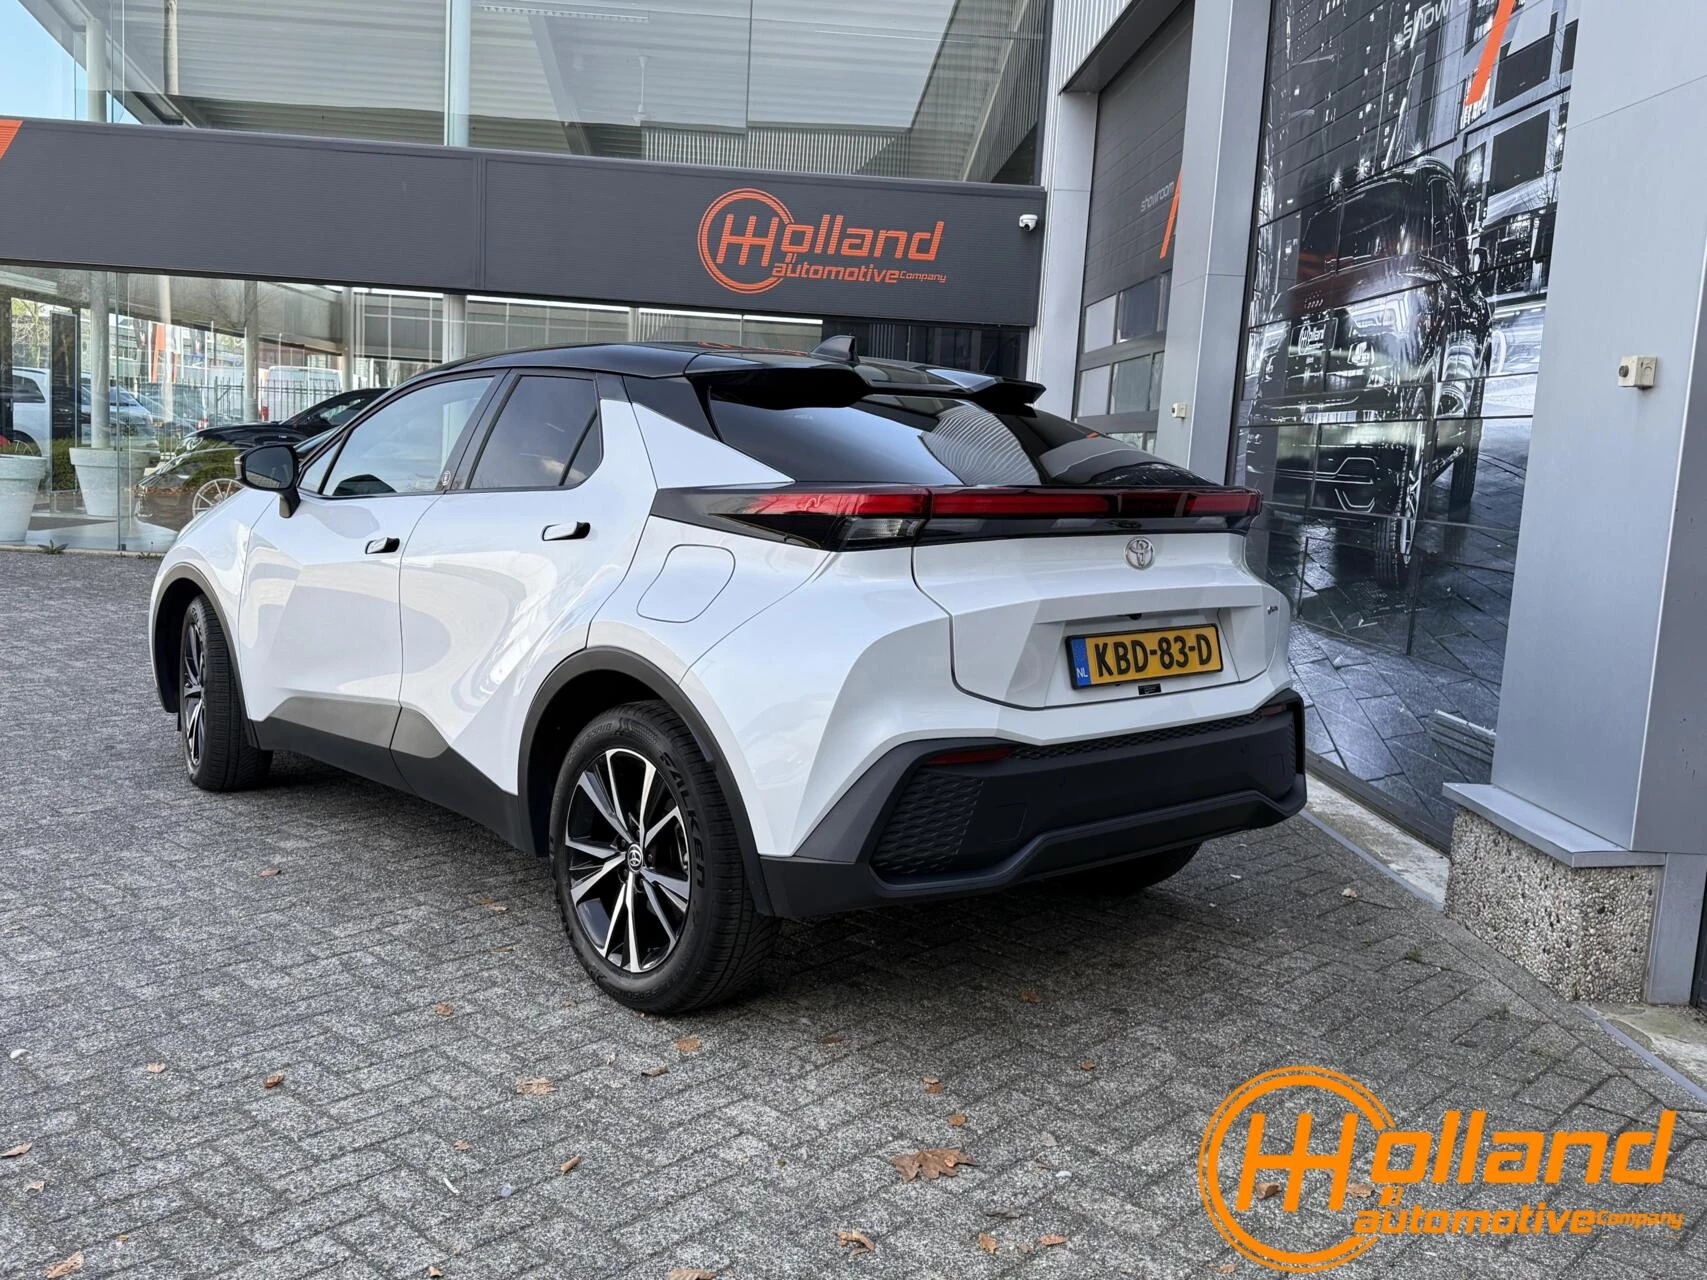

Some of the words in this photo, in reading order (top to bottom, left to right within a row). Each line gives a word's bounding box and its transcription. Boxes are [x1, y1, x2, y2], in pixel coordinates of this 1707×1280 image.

[716, 213, 945, 267] Holland
[772, 261, 899, 283] automotive
[899, 270, 947, 284] Company
[1095, 634, 1213, 678] KBD-83-D
[1076, 667, 1089, 679] NL
